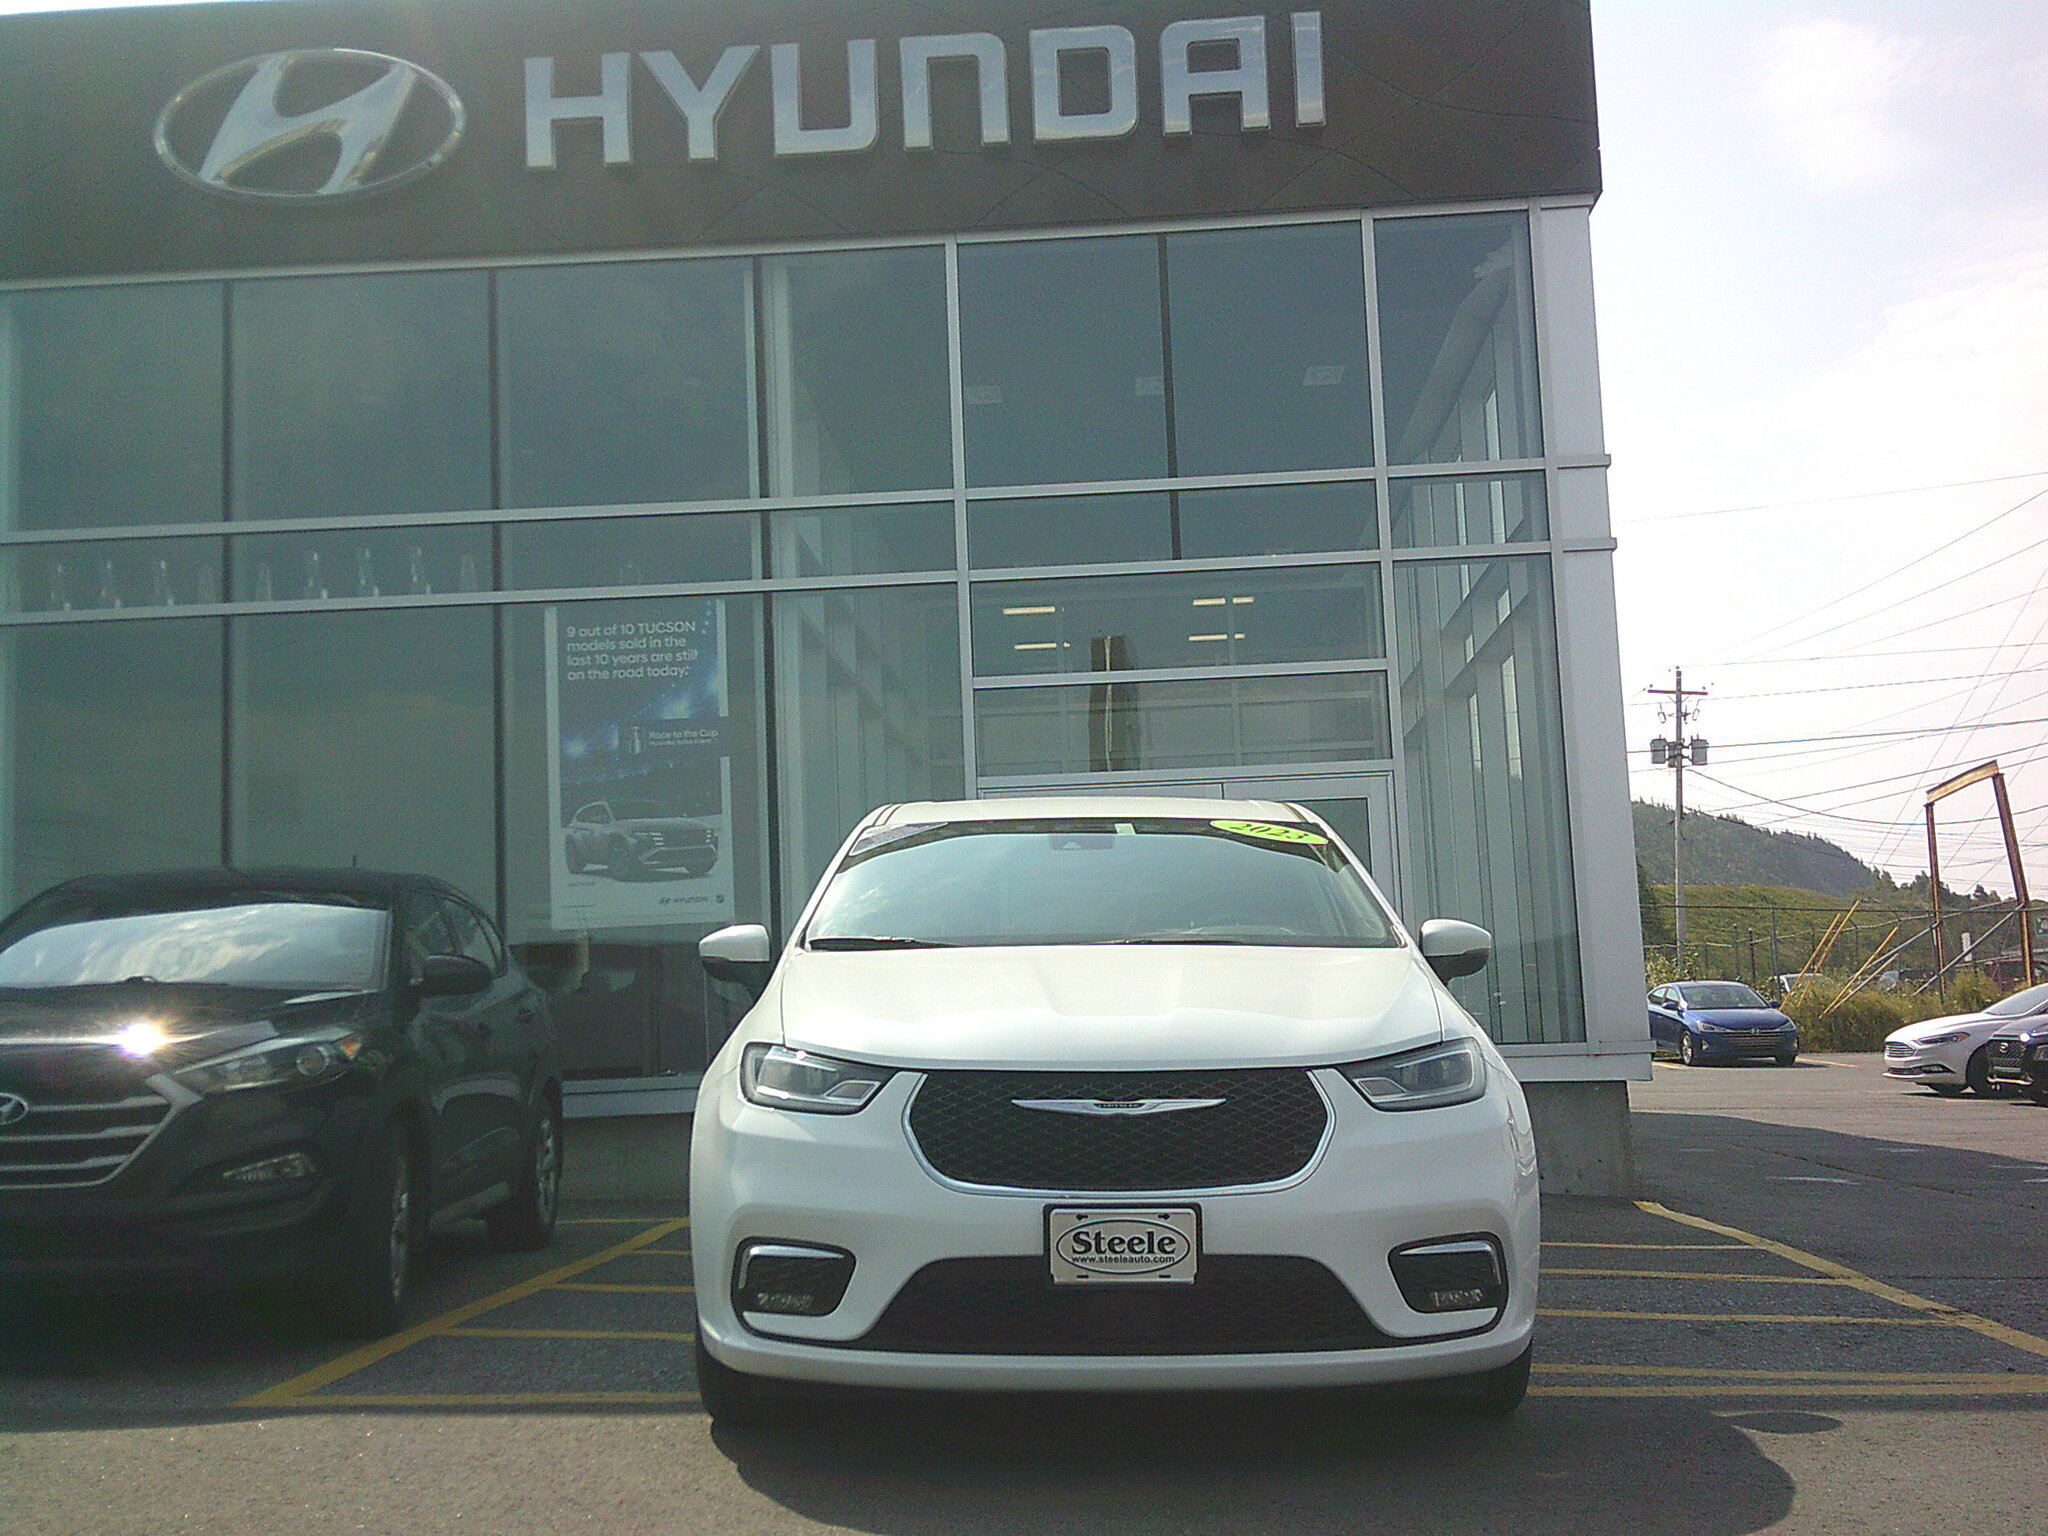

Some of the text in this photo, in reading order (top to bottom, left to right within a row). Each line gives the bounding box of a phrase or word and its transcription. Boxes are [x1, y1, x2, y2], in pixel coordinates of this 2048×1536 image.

[521, 11, 1326, 170] HYUNDAI
[566, 621, 696, 638] 9 out of 10 TUCSON
[566, 636, 687, 652] models sold in the
[566, 649, 699, 667] last 10 years are still
[567, 670, 585, 681] on
[587, 669, 610, 680] the
[612, 666, 644, 679] road
[648, 731, 672, 740] Race
[683, 730, 698, 738] the
[699, 729, 719, 739] Cup
[1229, 823, 1310, 840] 2023
[1071, 1230, 1177, 1255] Steele
[1071, 1254, 1176, 1264] www.steeleauto.com
